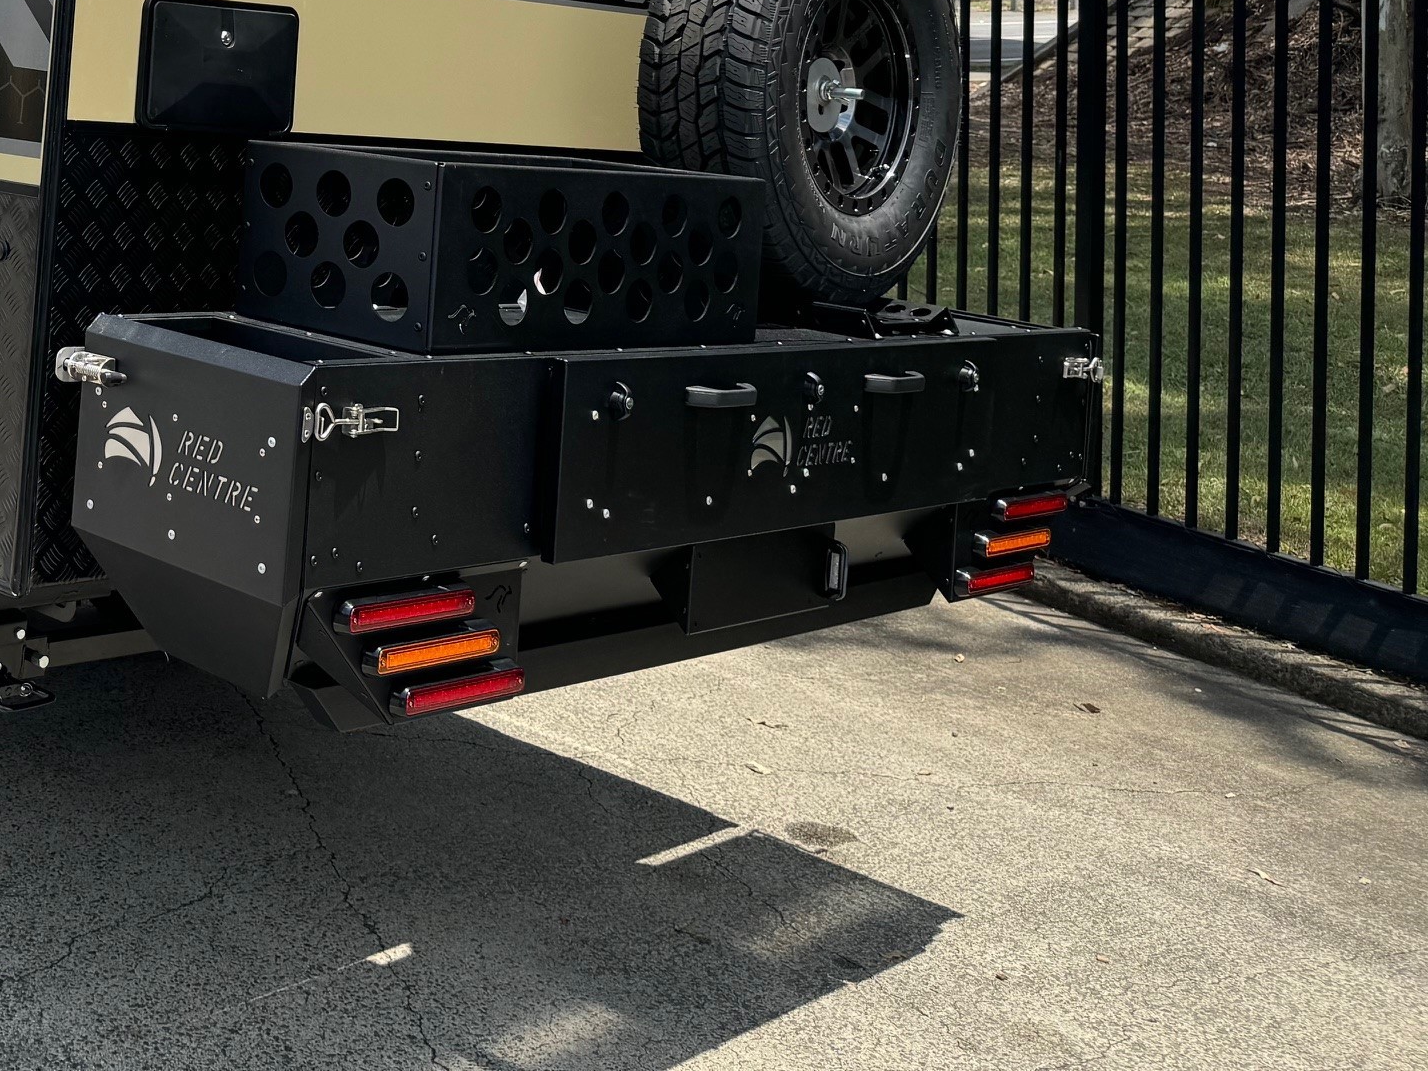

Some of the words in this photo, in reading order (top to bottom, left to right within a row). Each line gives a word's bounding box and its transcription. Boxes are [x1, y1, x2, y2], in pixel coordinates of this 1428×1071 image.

[802, 415, 833, 438] RED
[177, 430, 223, 464] RED
[796, 440, 853, 467] CENTRE
[169, 462, 259, 511] CENTRE
